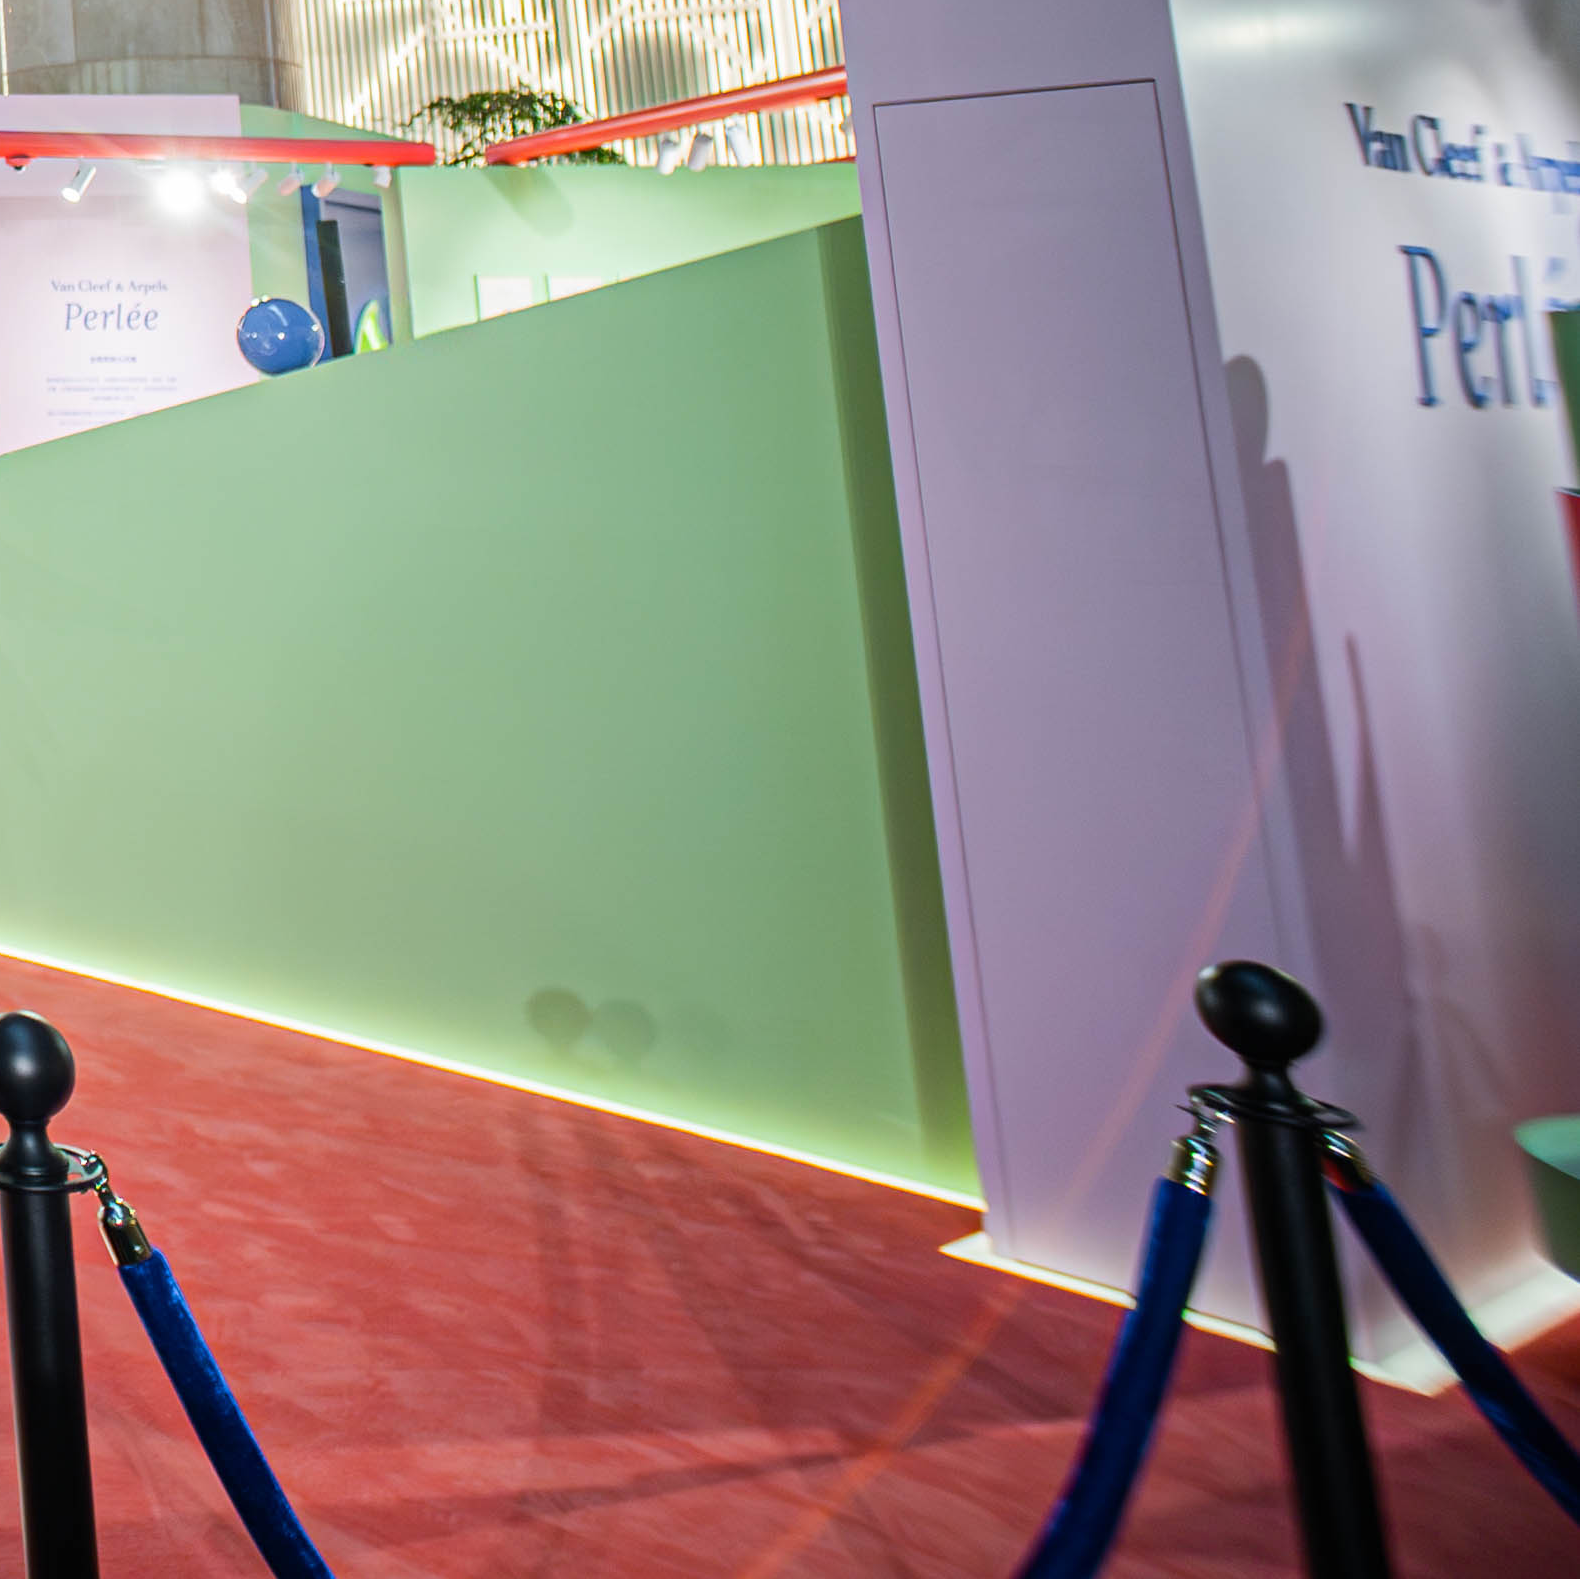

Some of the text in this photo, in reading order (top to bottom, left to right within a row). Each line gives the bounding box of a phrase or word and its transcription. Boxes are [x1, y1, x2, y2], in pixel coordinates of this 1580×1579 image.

[50, 279, 75, 292] Van
[77, 279, 112, 292] Cleef
[129, 279, 168, 297] Arpels
[64, 301, 159, 332] Perlée
